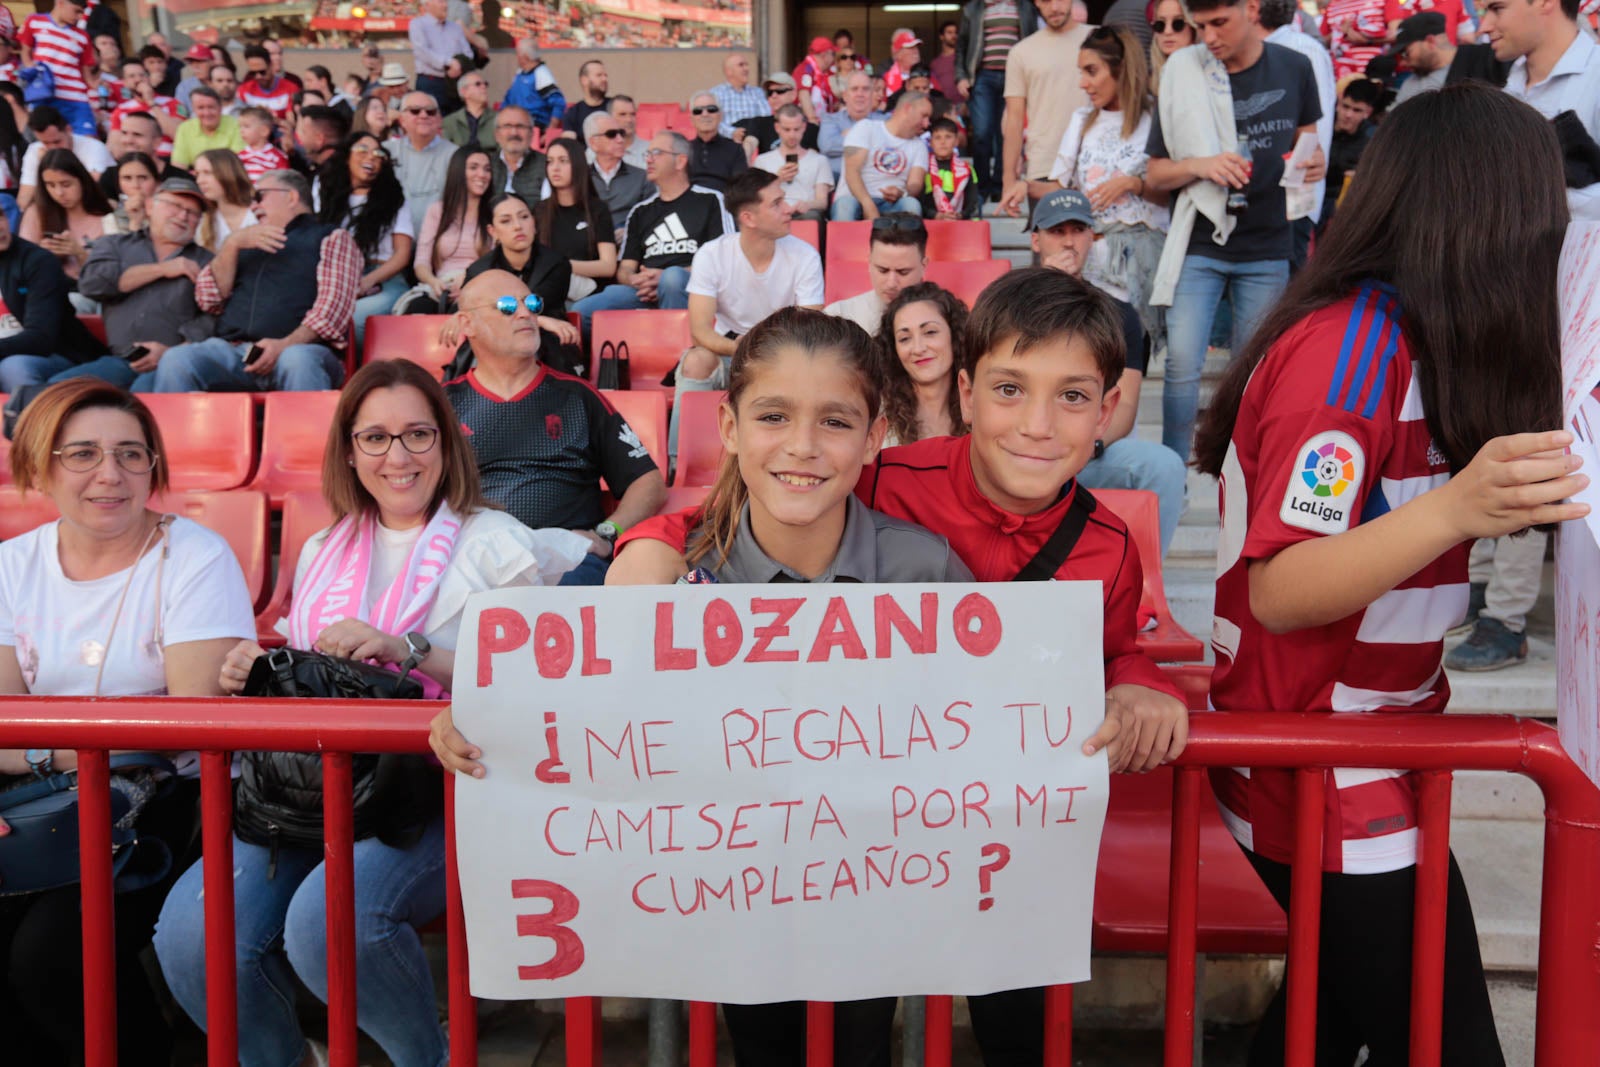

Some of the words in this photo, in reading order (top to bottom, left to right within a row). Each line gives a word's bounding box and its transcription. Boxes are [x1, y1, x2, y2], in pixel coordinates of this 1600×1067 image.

[1246, 119, 1295, 135] MARTIN
[643, 239, 699, 259] adidas
[1290, 496, 1344, 522] LaLiga
[476, 605, 613, 688] POL
[653, 591, 1004, 672] LOZANO
[722, 700, 973, 770] REGALAS
[1003, 702, 1073, 754] TU
[543, 794, 848, 857] CAMISETA
[891, 781, 993, 838] POR
[1015, 783, 1089, 829] MI
[630, 844, 952, 917] CUMPLEAÑOS
[510, 877, 586, 982] 3
